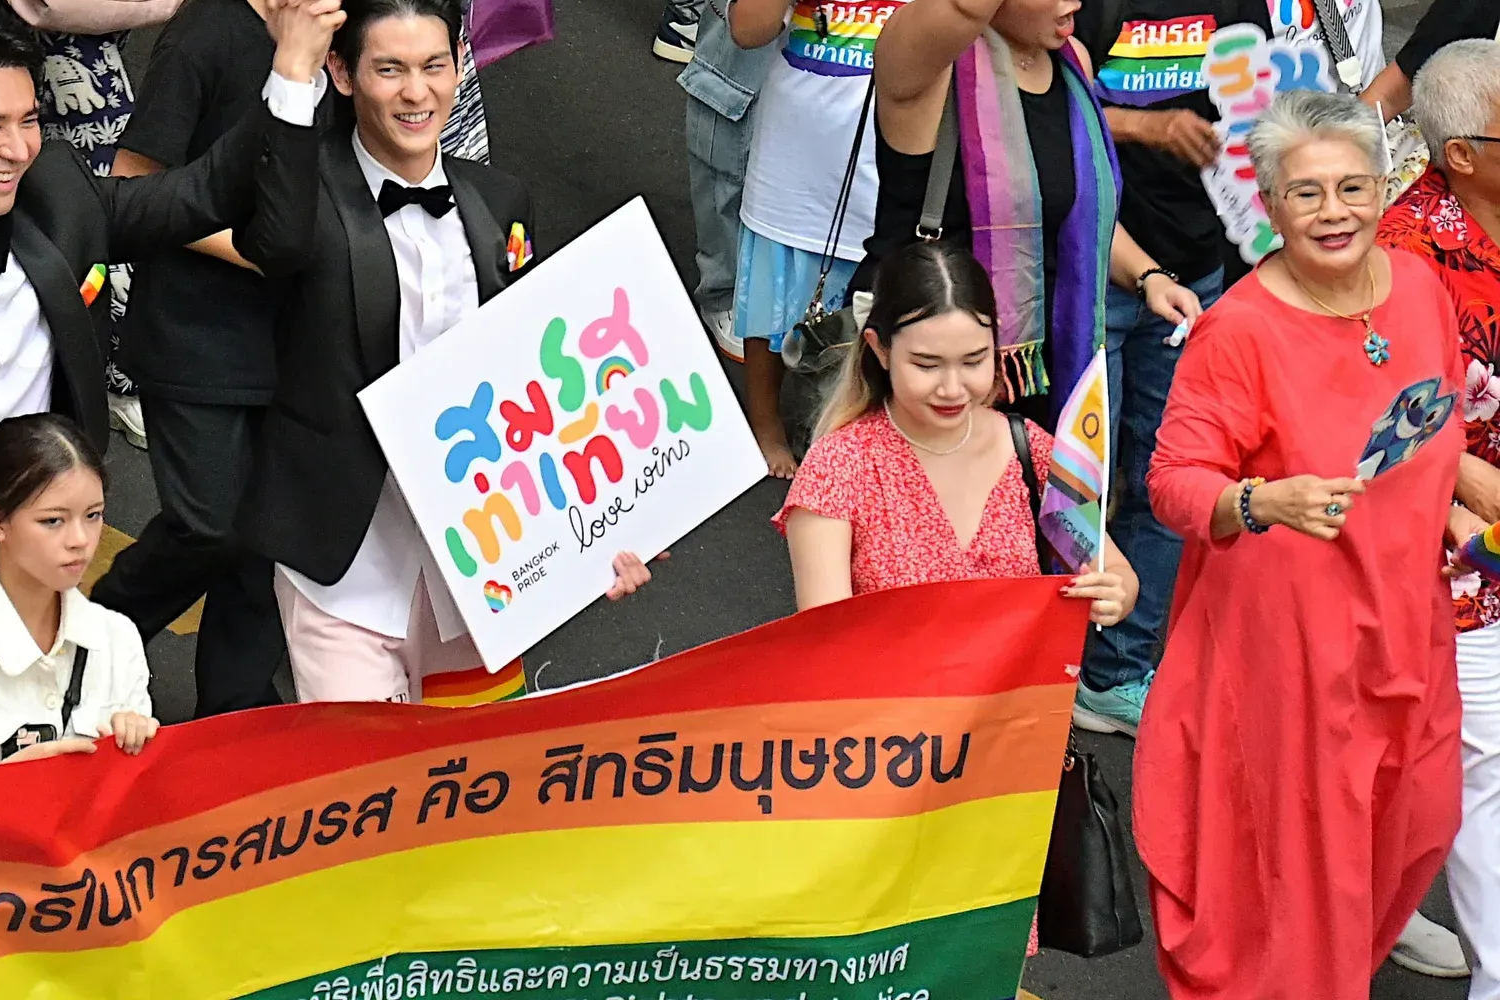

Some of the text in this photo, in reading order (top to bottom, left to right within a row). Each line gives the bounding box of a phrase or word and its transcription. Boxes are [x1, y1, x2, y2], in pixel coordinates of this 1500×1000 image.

[804, 37, 874, 70] เท่าเทีย
[1130, 20, 1204, 49] สมรส
[435, 287, 649, 483] สมรส
[445, 372, 712, 578] เท่าเทียม
[568, 439, 690, 553] love wins
[511, 541, 560, 581] BANGKOK
[517, 567, 548, 593] PRIDE
[416, 757, 510, 825] คือ
[538, 731, 972, 814] สิทธิมนุษยชน
